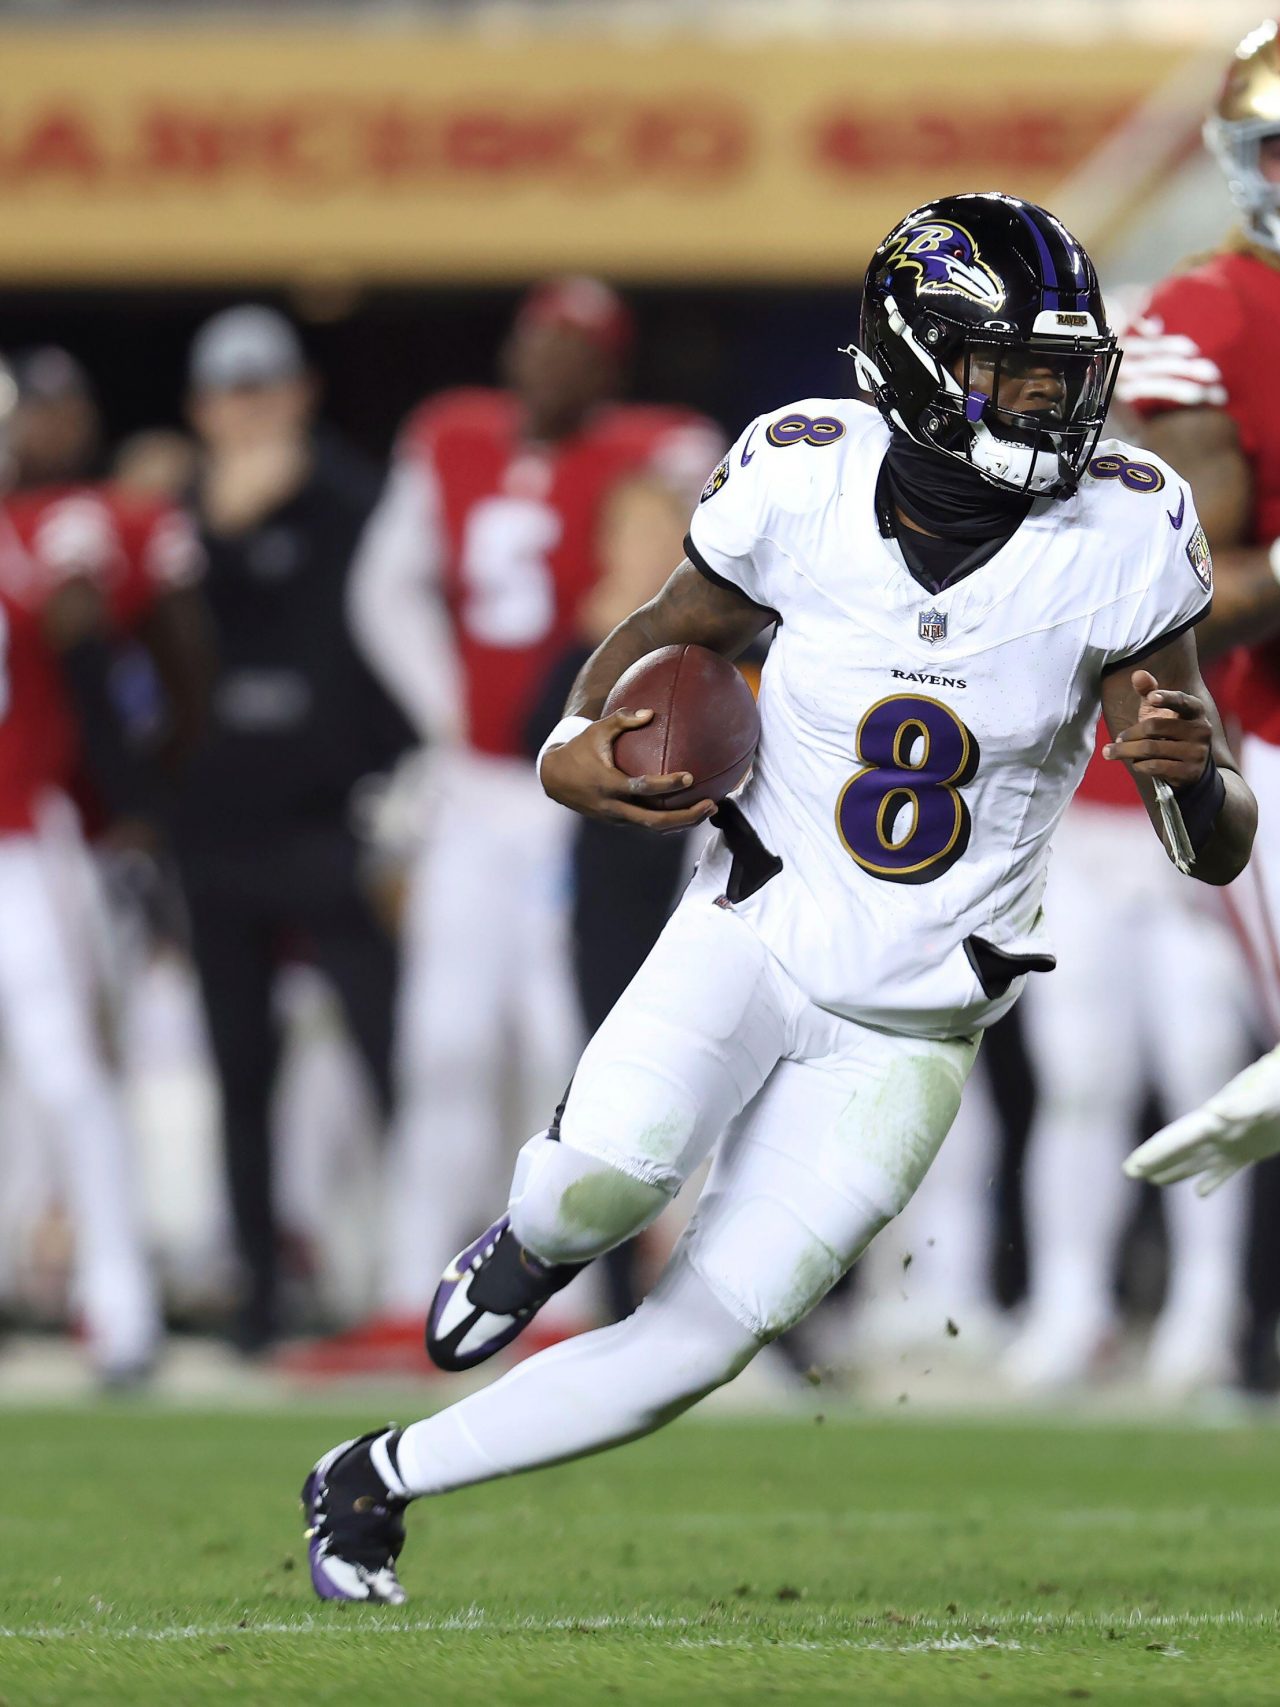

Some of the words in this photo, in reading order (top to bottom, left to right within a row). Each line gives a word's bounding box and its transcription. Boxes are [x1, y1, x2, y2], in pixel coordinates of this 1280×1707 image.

[904, 225, 953, 253] B
[766, 413, 847, 447] 8
[1087, 454, 1165, 493] 8
[922, 624, 944, 638] NFL
[890, 669, 967, 689] RAVENS
[835, 693, 980, 885] 8
